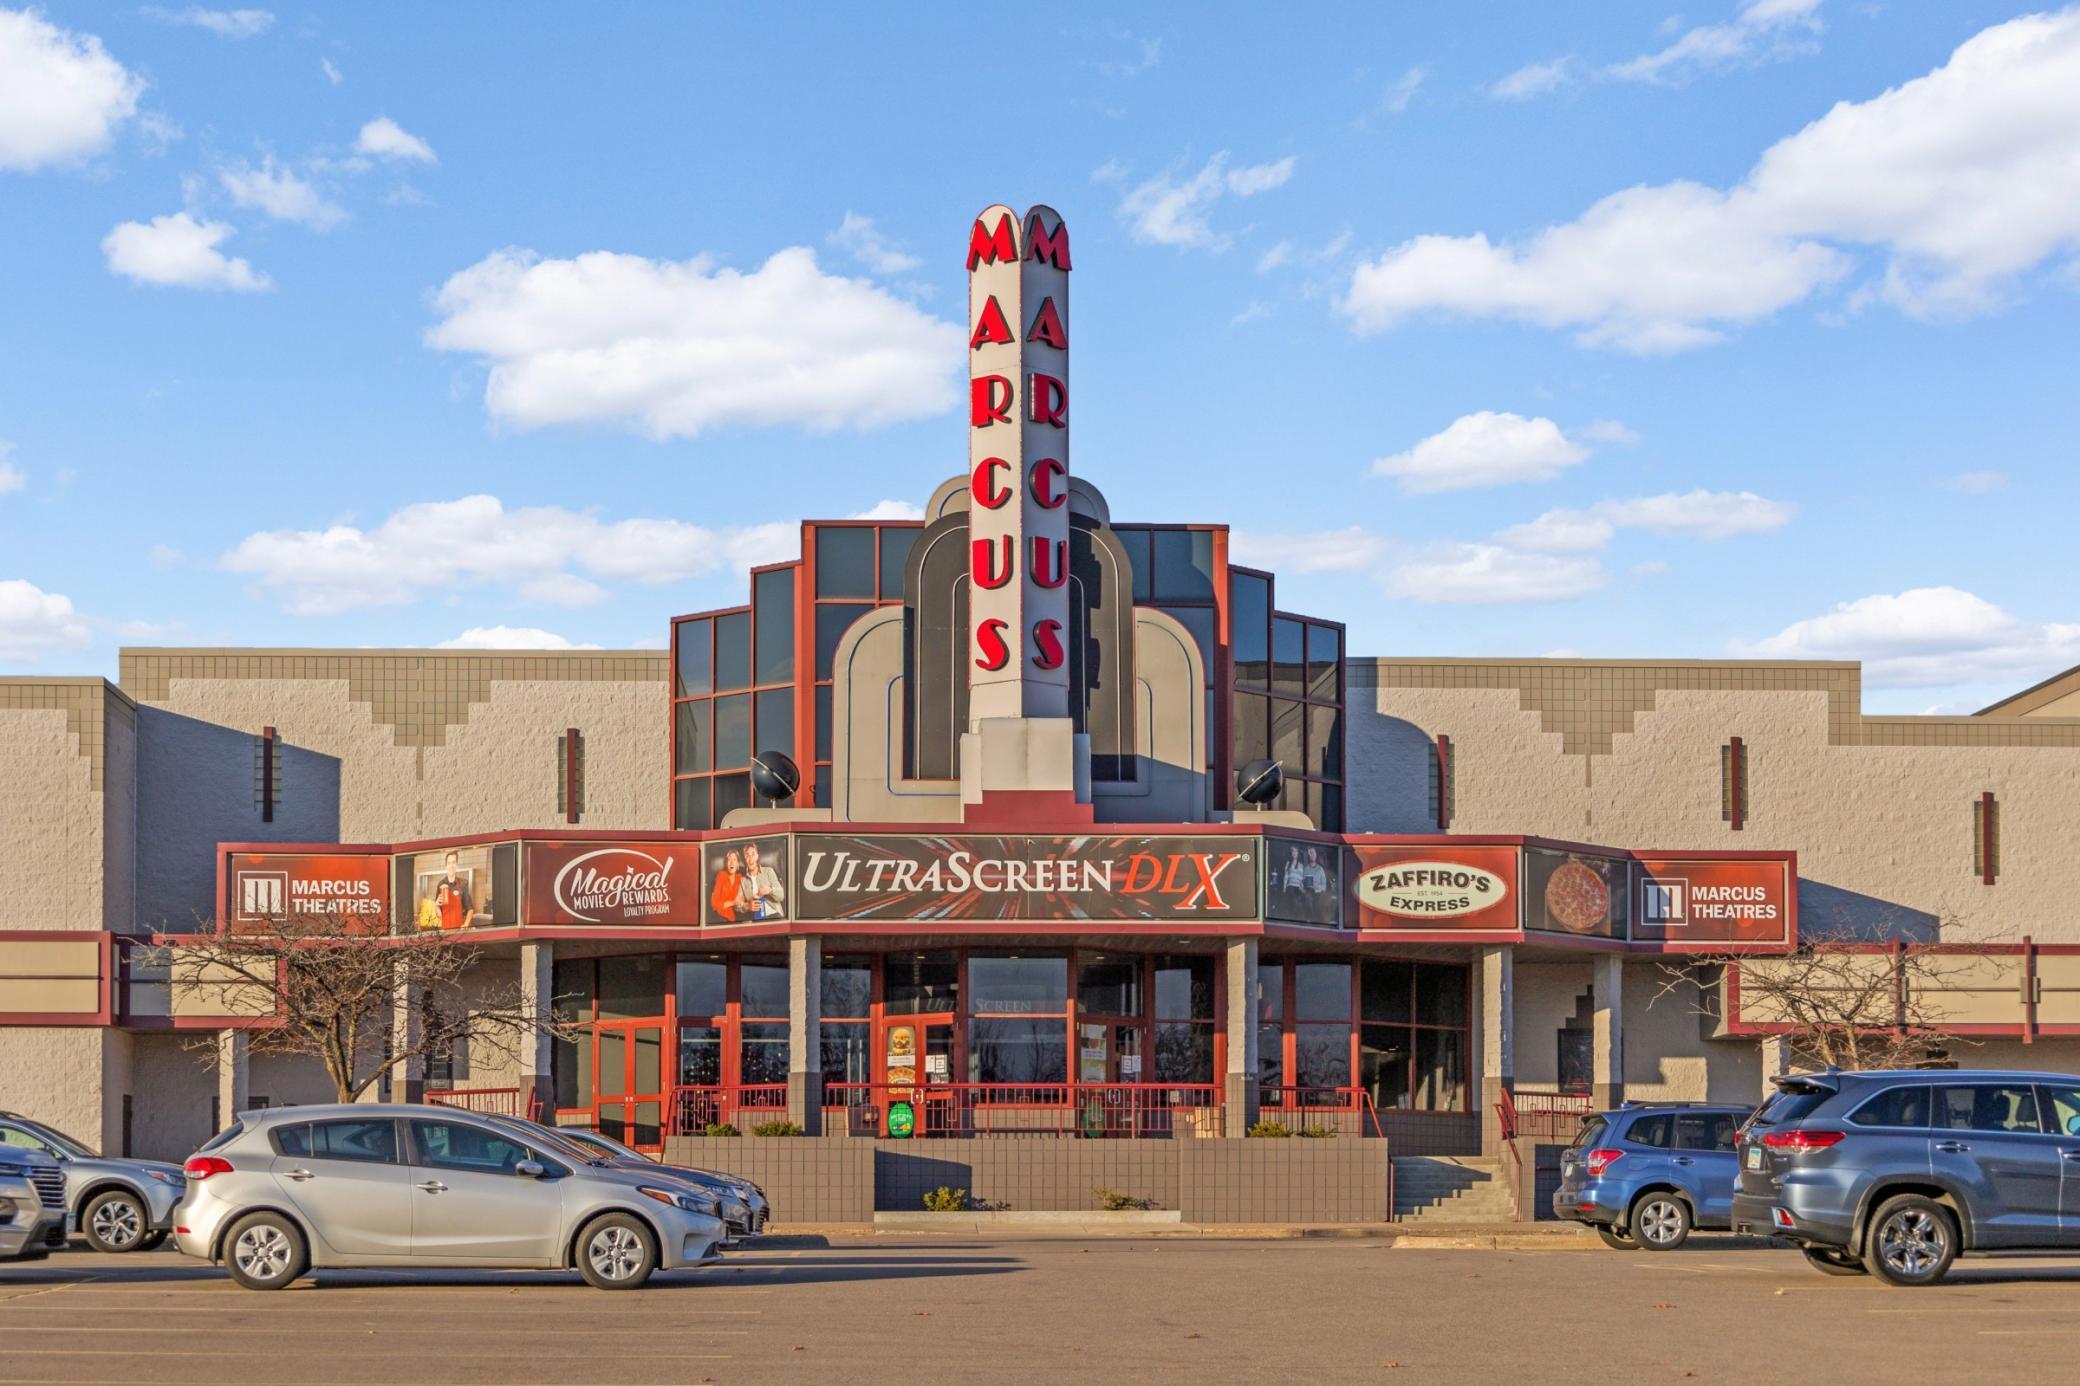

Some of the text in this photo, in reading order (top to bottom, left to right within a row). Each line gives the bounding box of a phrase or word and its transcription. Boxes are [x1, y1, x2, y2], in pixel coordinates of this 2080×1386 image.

[966, 213, 1018, 672] MARCUS
[1023, 213, 1072, 671] MARCUS
[292, 880, 370, 895] MARCUS
[570, 856, 674, 908] Magical
[1370, 870, 1491, 893] ZAFFIRO'S
[573, 888, 669, 910] MOVIE REWARDS
[1692, 886, 1766, 901] MARCUS
[292, 898, 381, 914] THEATRES
[1390, 896, 1470, 911] EXPRESS
[1692, 904, 1777, 919] THEATRES
